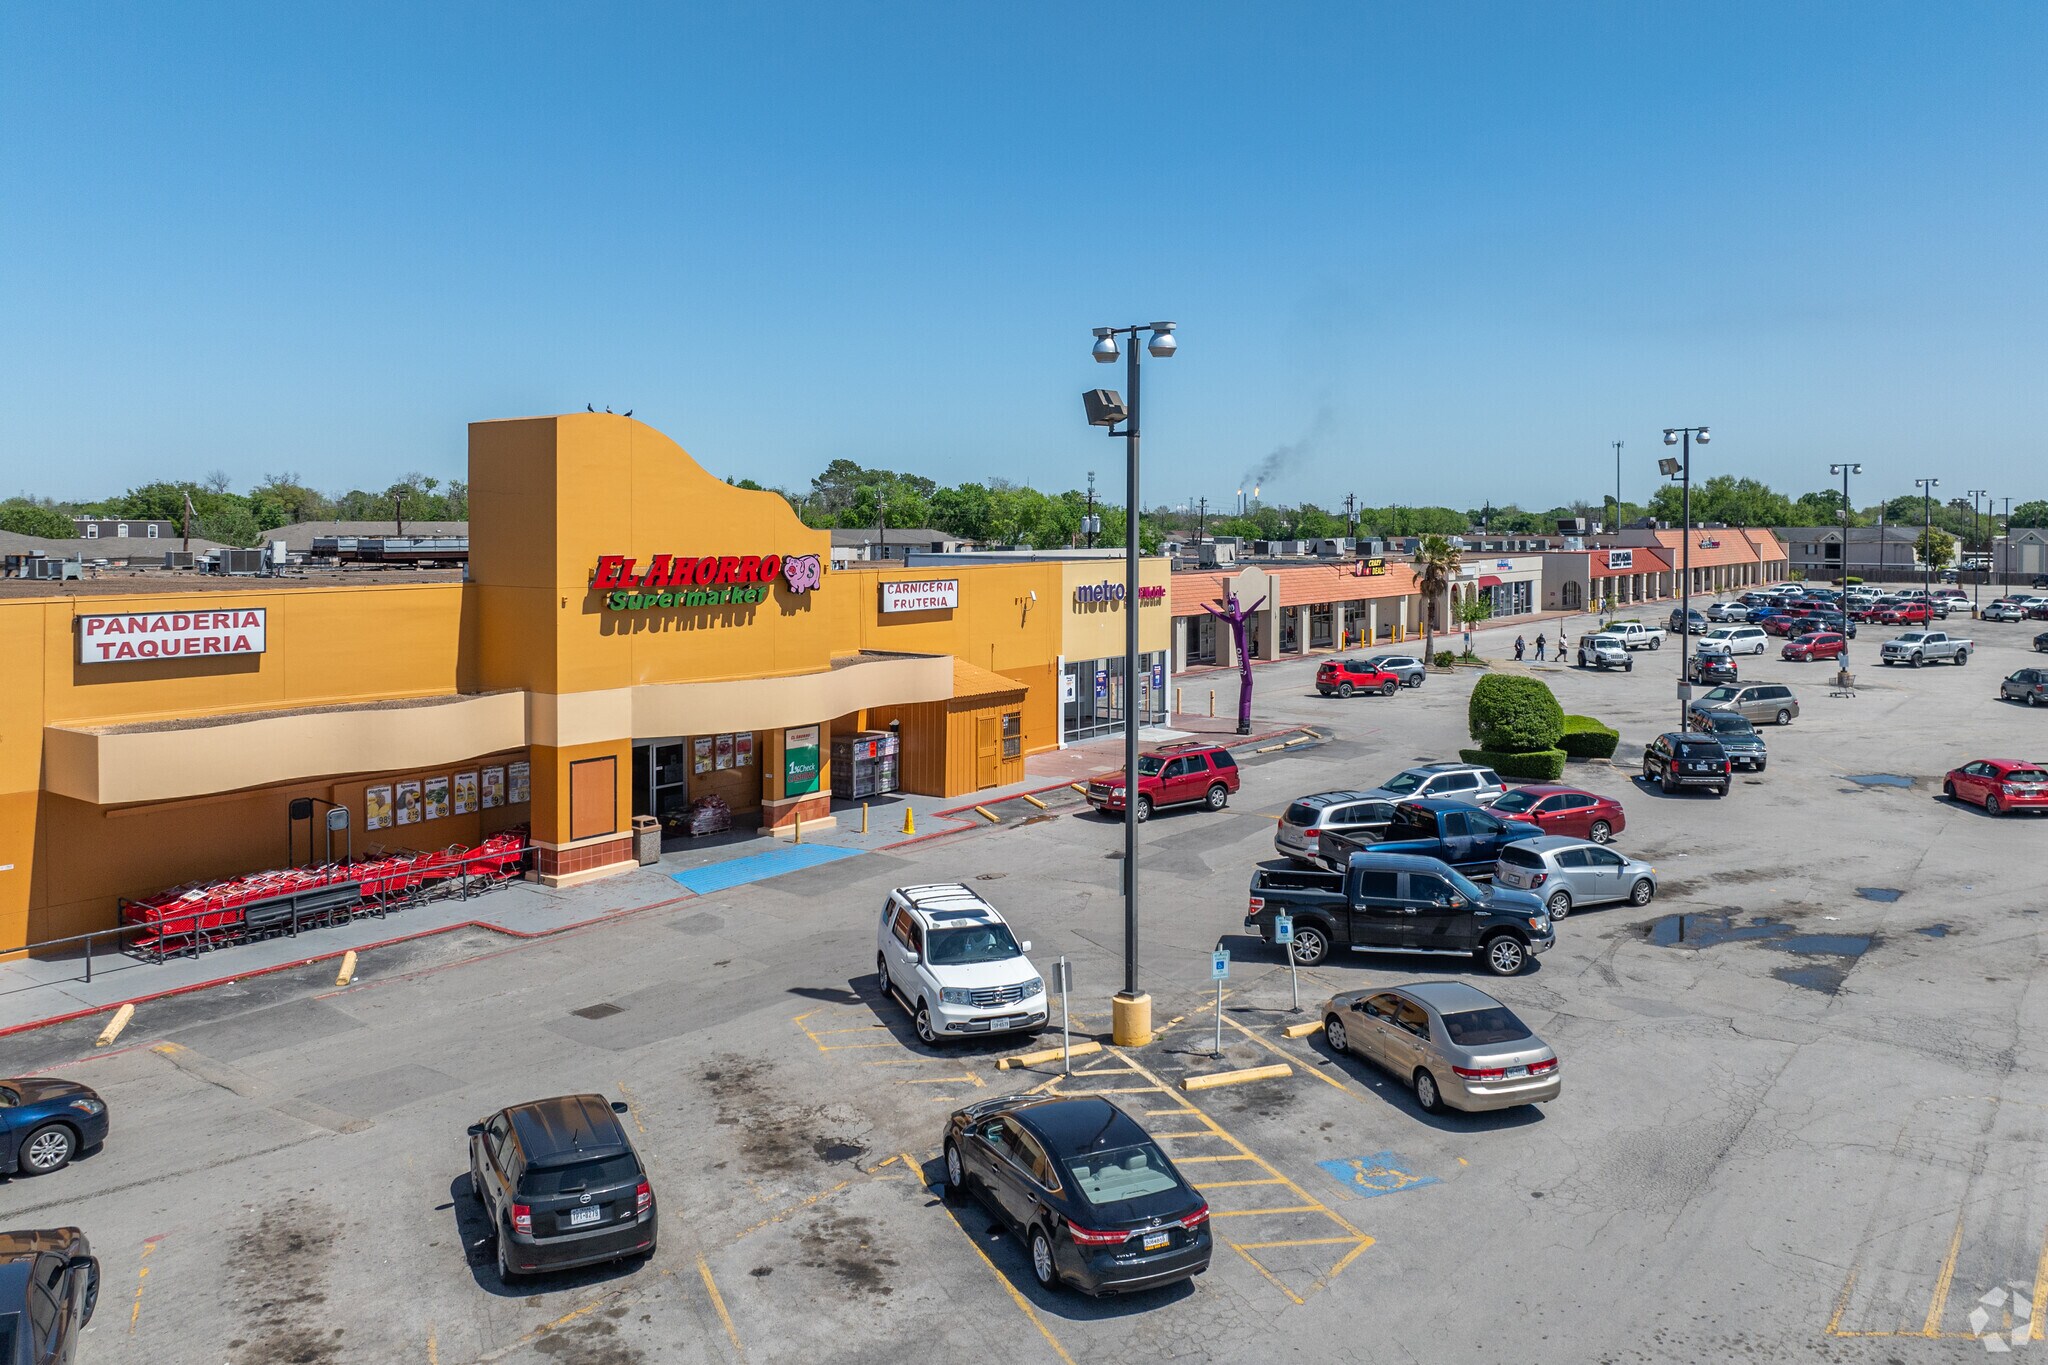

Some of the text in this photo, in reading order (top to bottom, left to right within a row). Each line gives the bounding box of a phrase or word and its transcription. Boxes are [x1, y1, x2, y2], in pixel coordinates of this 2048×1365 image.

[592, 554, 781, 589] EL AHORRO
[608, 585, 768, 611] Supermarket
[887, 581, 954, 594] CARNICERIA
[1077, 580, 1125, 602] metro
[893, 596, 948, 609] FRUTERIA
[86, 611, 261, 636] PANADERIA
[96, 635, 252, 660] TAQUERIA
